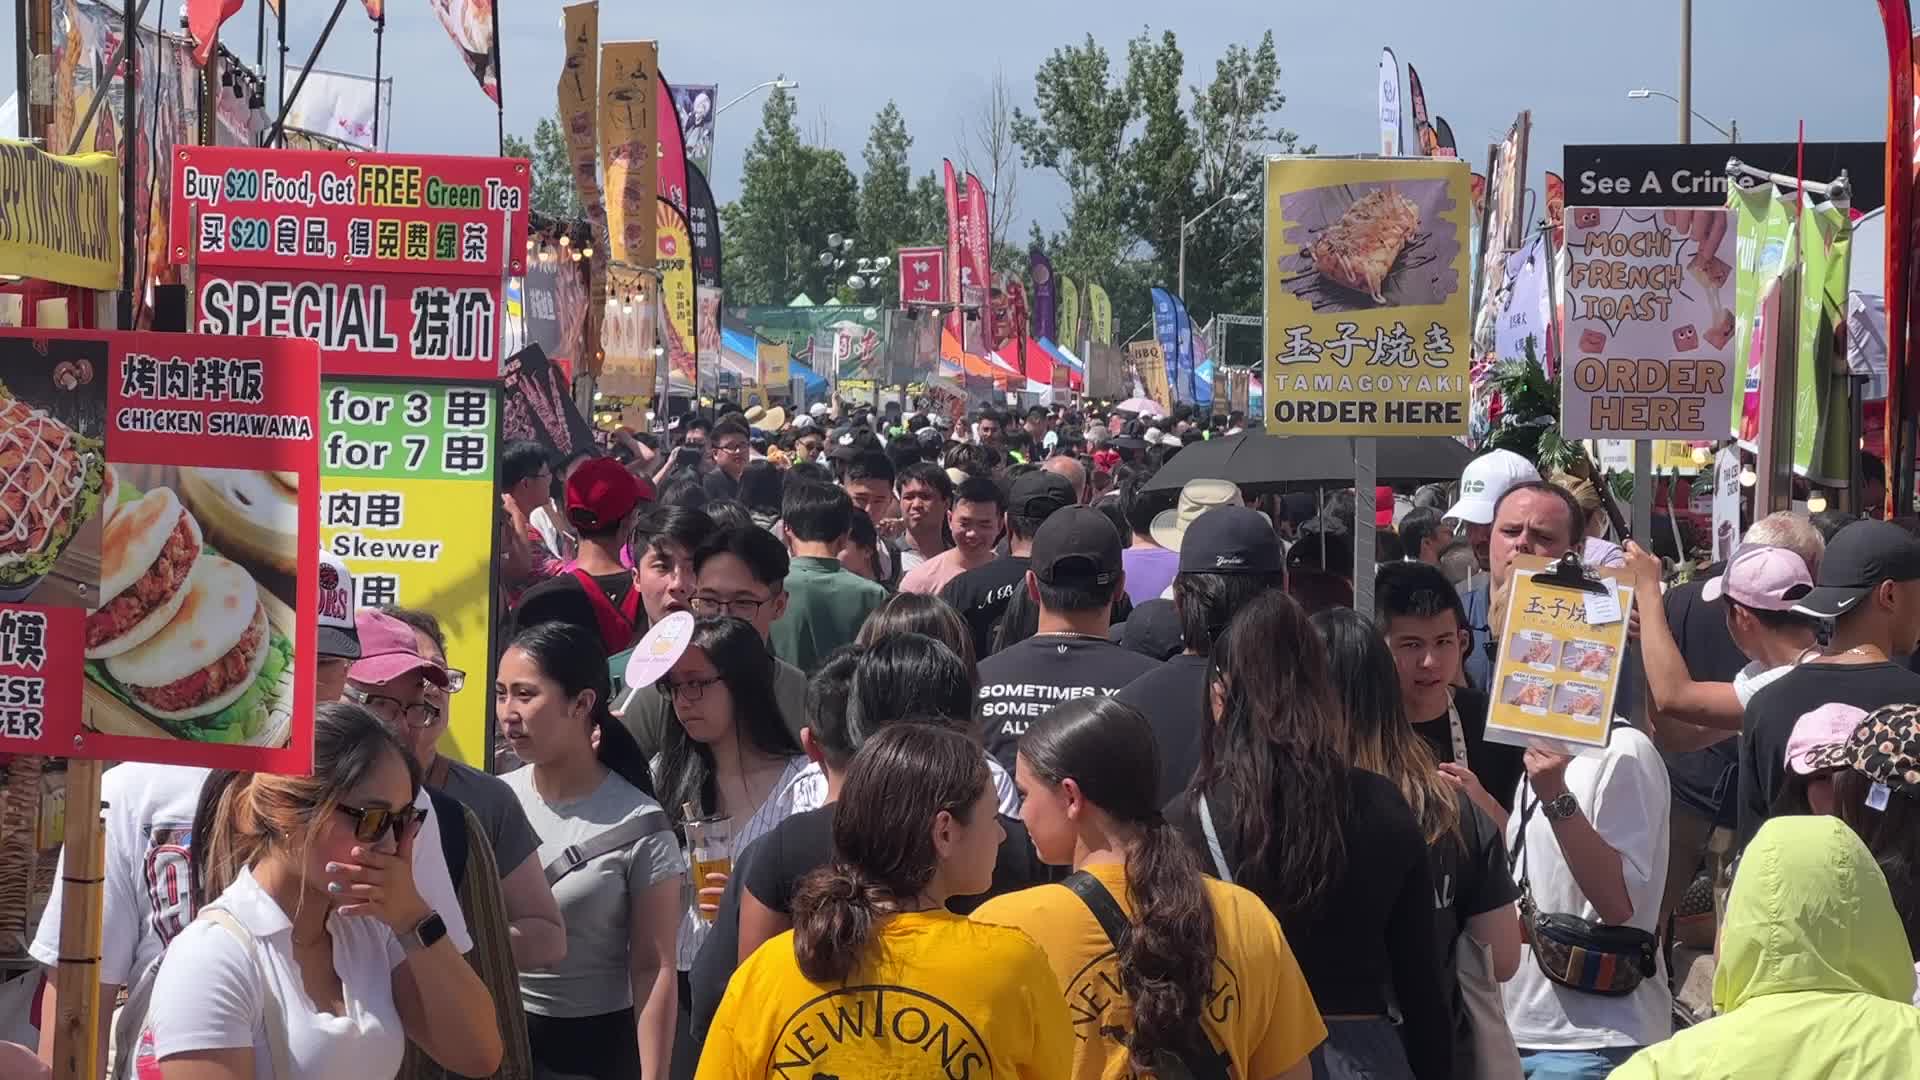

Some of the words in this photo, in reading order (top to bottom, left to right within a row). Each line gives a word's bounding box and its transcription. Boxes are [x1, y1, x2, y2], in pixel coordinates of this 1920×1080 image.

[186, 169, 221, 204] Buy
[225, 171, 259, 200] $20
[263, 171, 315, 205] Food,
[321, 173, 354, 203] Get
[359, 166, 421, 205] FREE
[427, 178, 481, 207] Green
[488, 179, 521, 210] Tea
[1580, 170, 1631, 194] See
[1640, 170, 1662, 193] A
[202, 215, 225, 250] 买
[231, 221, 269, 250] $20
[1571, 259, 1683, 290] FRENCH
[203, 280, 397, 350] SPECIAL
[412, 289, 493, 359] 特价
[1582, 291, 1672, 321] TOAST
[1276, 321, 1454, 368] 玉子焼き
[121, 354, 264, 402] 烤肉拌饭
[1275, 374, 1463, 393] TAMAGOYAKI
[1574, 357, 1726, 393] ORDER
[208, 412, 313, 440] SHAWAMA
[329, 389, 391, 425] for
[405, 392, 428, 425] 3
[447, 389, 487, 429] 串
[1274, 400, 1378, 424] ORDER
[1385, 401, 1462, 424] HERE
[1591, 395, 1705, 431] HERE
[327, 434, 388, 469] for
[404, 437, 428, 470] 7
[445, 435, 485, 473] 串
[333, 535, 440, 560] Skewer
[979, 683, 1096, 701] SOMETIMES
